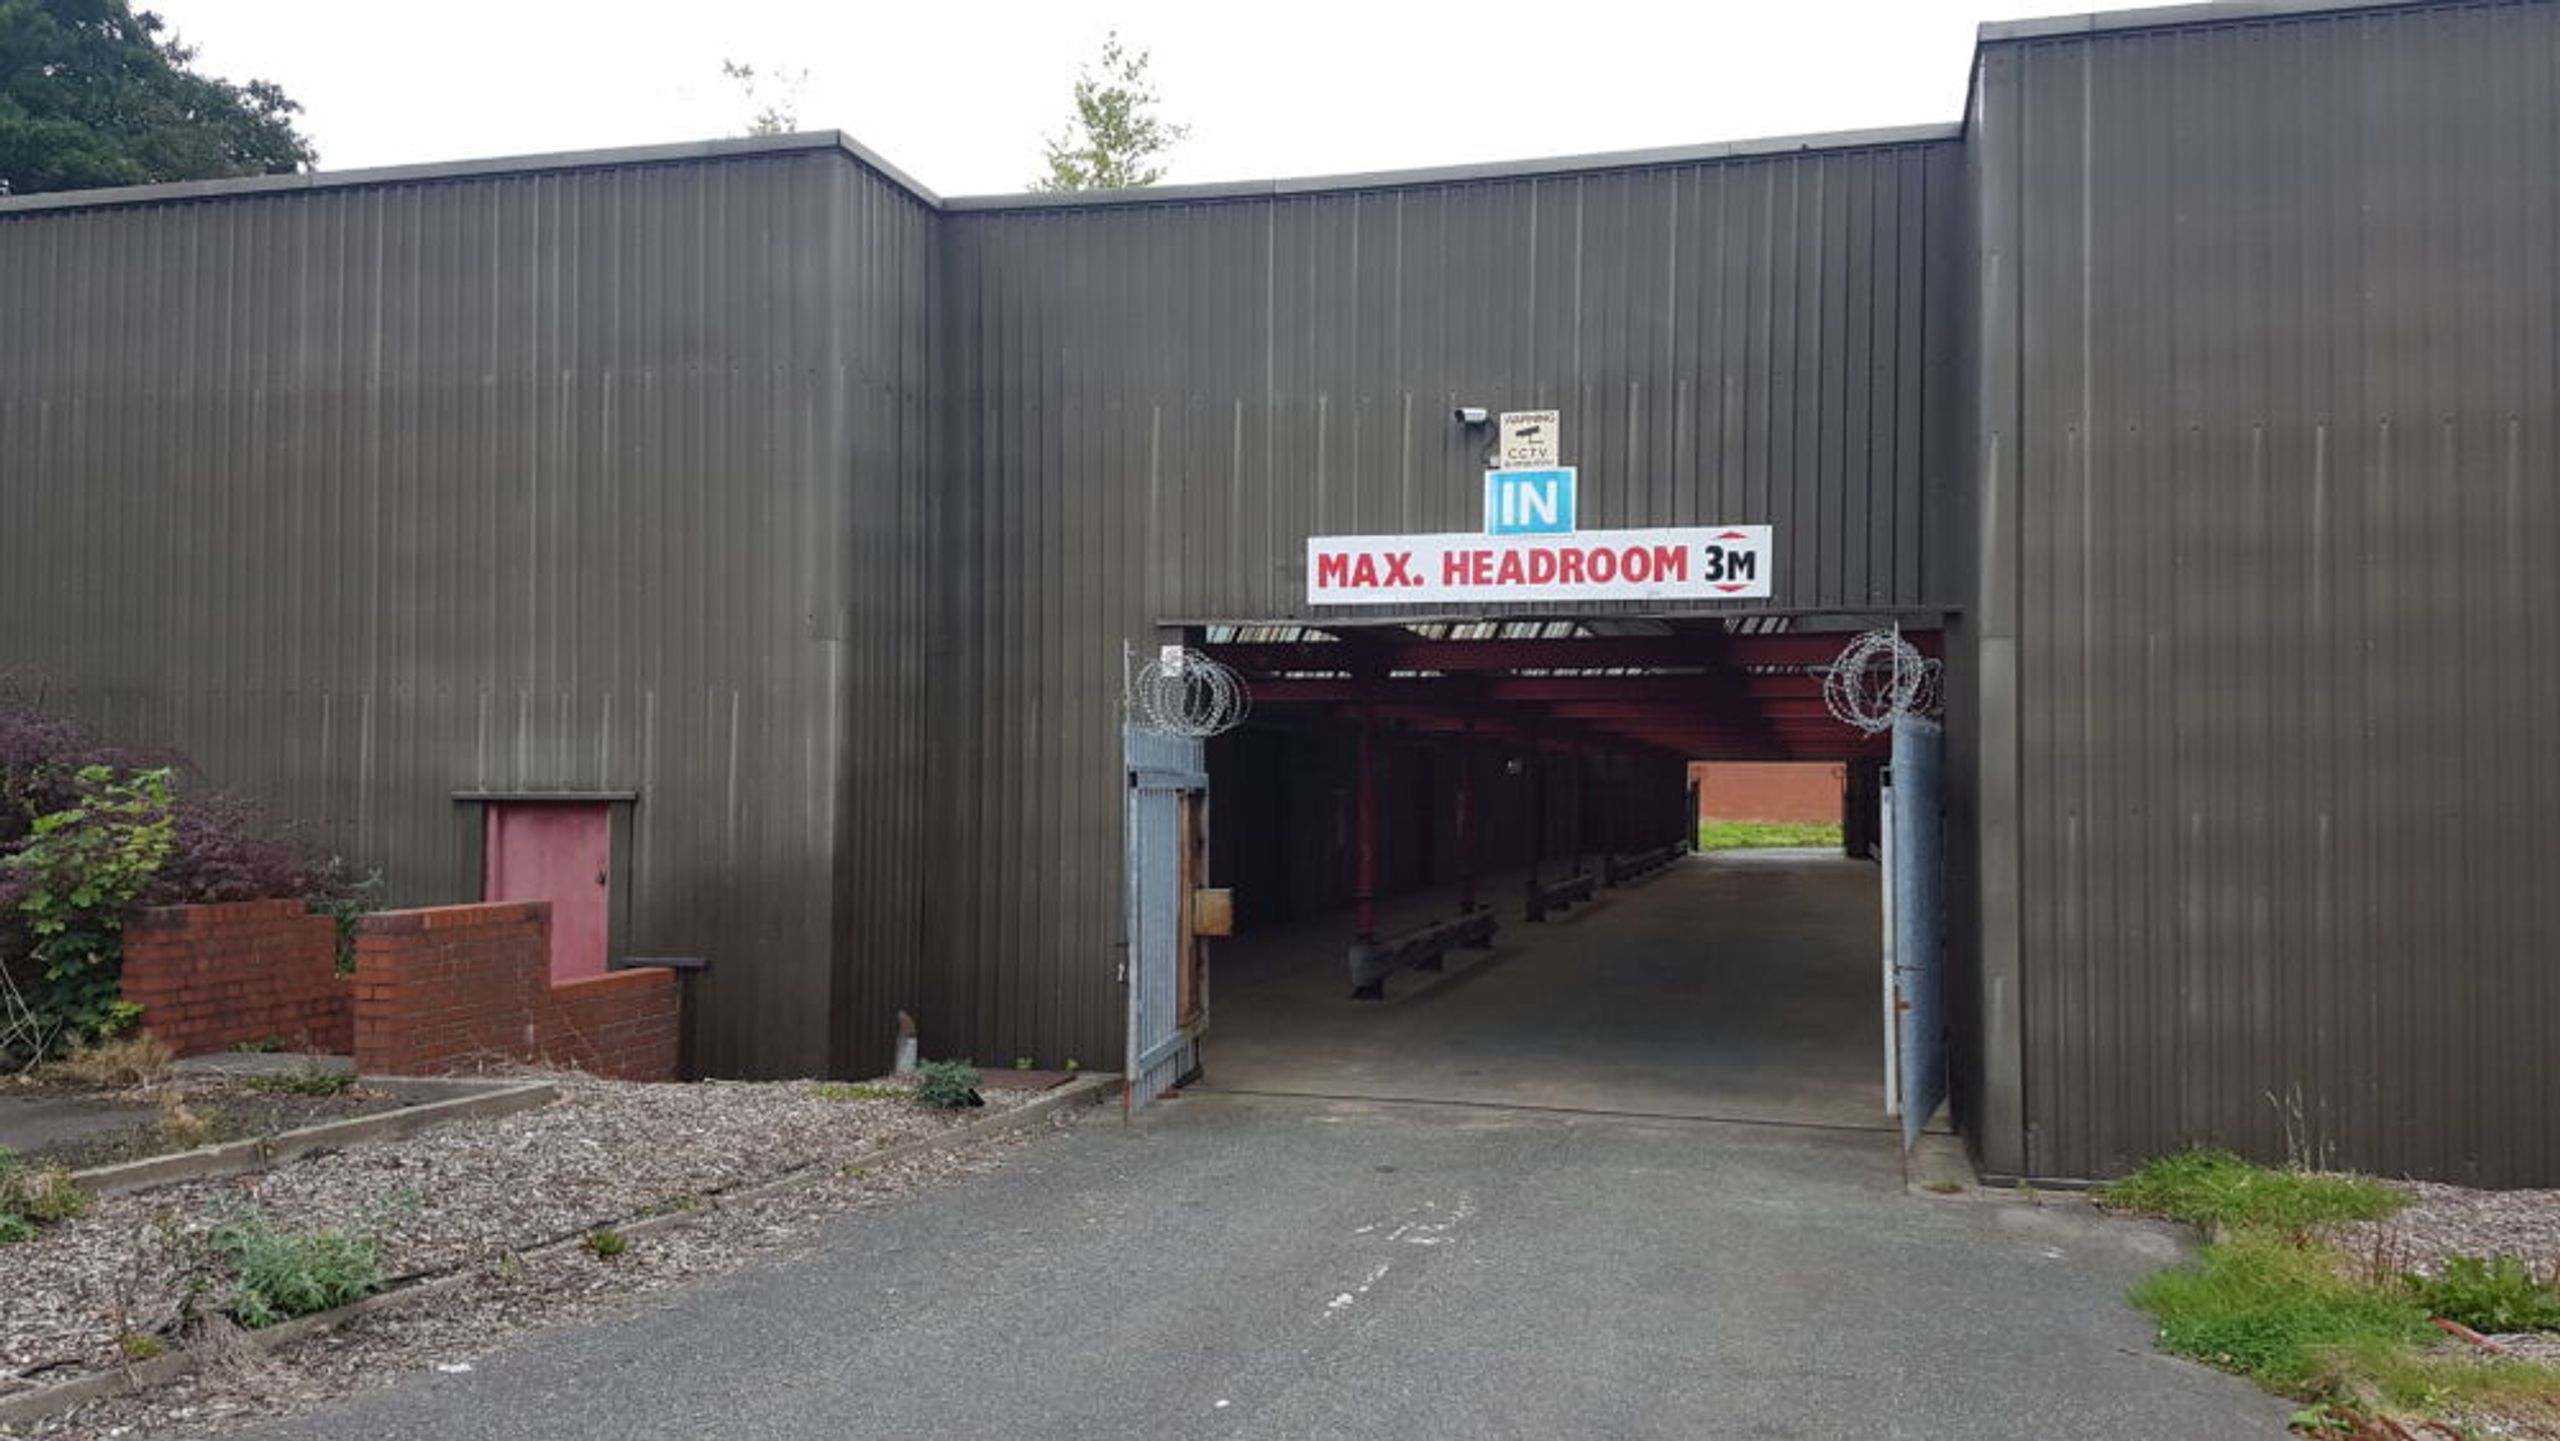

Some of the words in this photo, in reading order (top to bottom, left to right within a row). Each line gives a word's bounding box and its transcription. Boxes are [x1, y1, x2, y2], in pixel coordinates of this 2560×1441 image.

[1507, 447, 1548, 460] CCTV
[1502, 479, 1559, 526] IN
[1317, 552, 1425, 588] MAX.
[1443, 546, 1688, 586] HEADROOM
[1704, 545, 1756, 581] 3M
